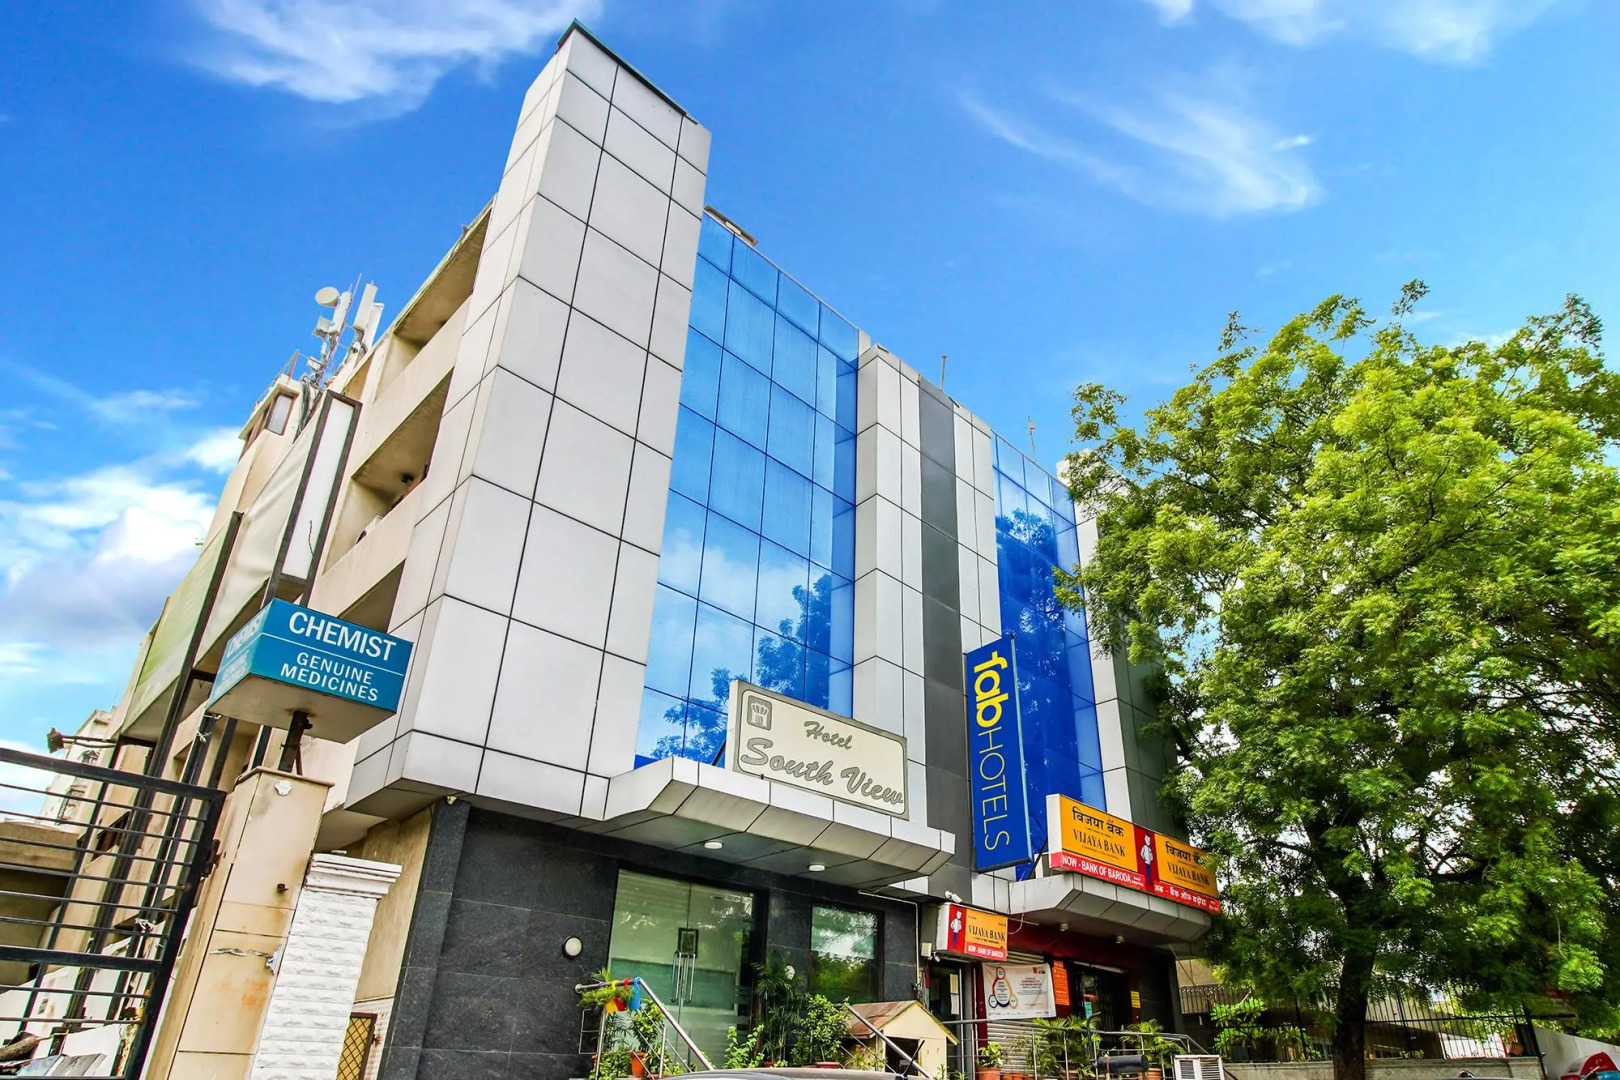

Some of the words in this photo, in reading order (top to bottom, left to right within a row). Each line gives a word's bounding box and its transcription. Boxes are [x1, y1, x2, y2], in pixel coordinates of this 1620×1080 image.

[289, 611, 396, 661] CHEMIST
[280, 663, 379, 702] MEDICINES
[296, 652, 374, 685] GENUINE
[803, 720, 852, 750] Hotel
[740, 737, 834, 785] South
[840, 766, 903, 804] View
[1072, 806, 1104, 830] विजया
[1107, 818, 1124, 837] बैंक
[1073, 829, 1102, 851] VIJAYA
[1104, 840, 1126, 857] BANK
[1165, 841, 1191, 861] विजया
[1062, 855, 1077, 867] NOW
[1082, 861, 1098, 875] BANK
[1099, 866, 1107, 876] OF
[1108, 869, 1131, 884] BARODA
[1167, 862, 1192, 879] VIJAYA
[1192, 870, 1210, 885] BANK
[968, 925, 989, 938] VIJAYA
[990, 930, 1006, 942] BANK
